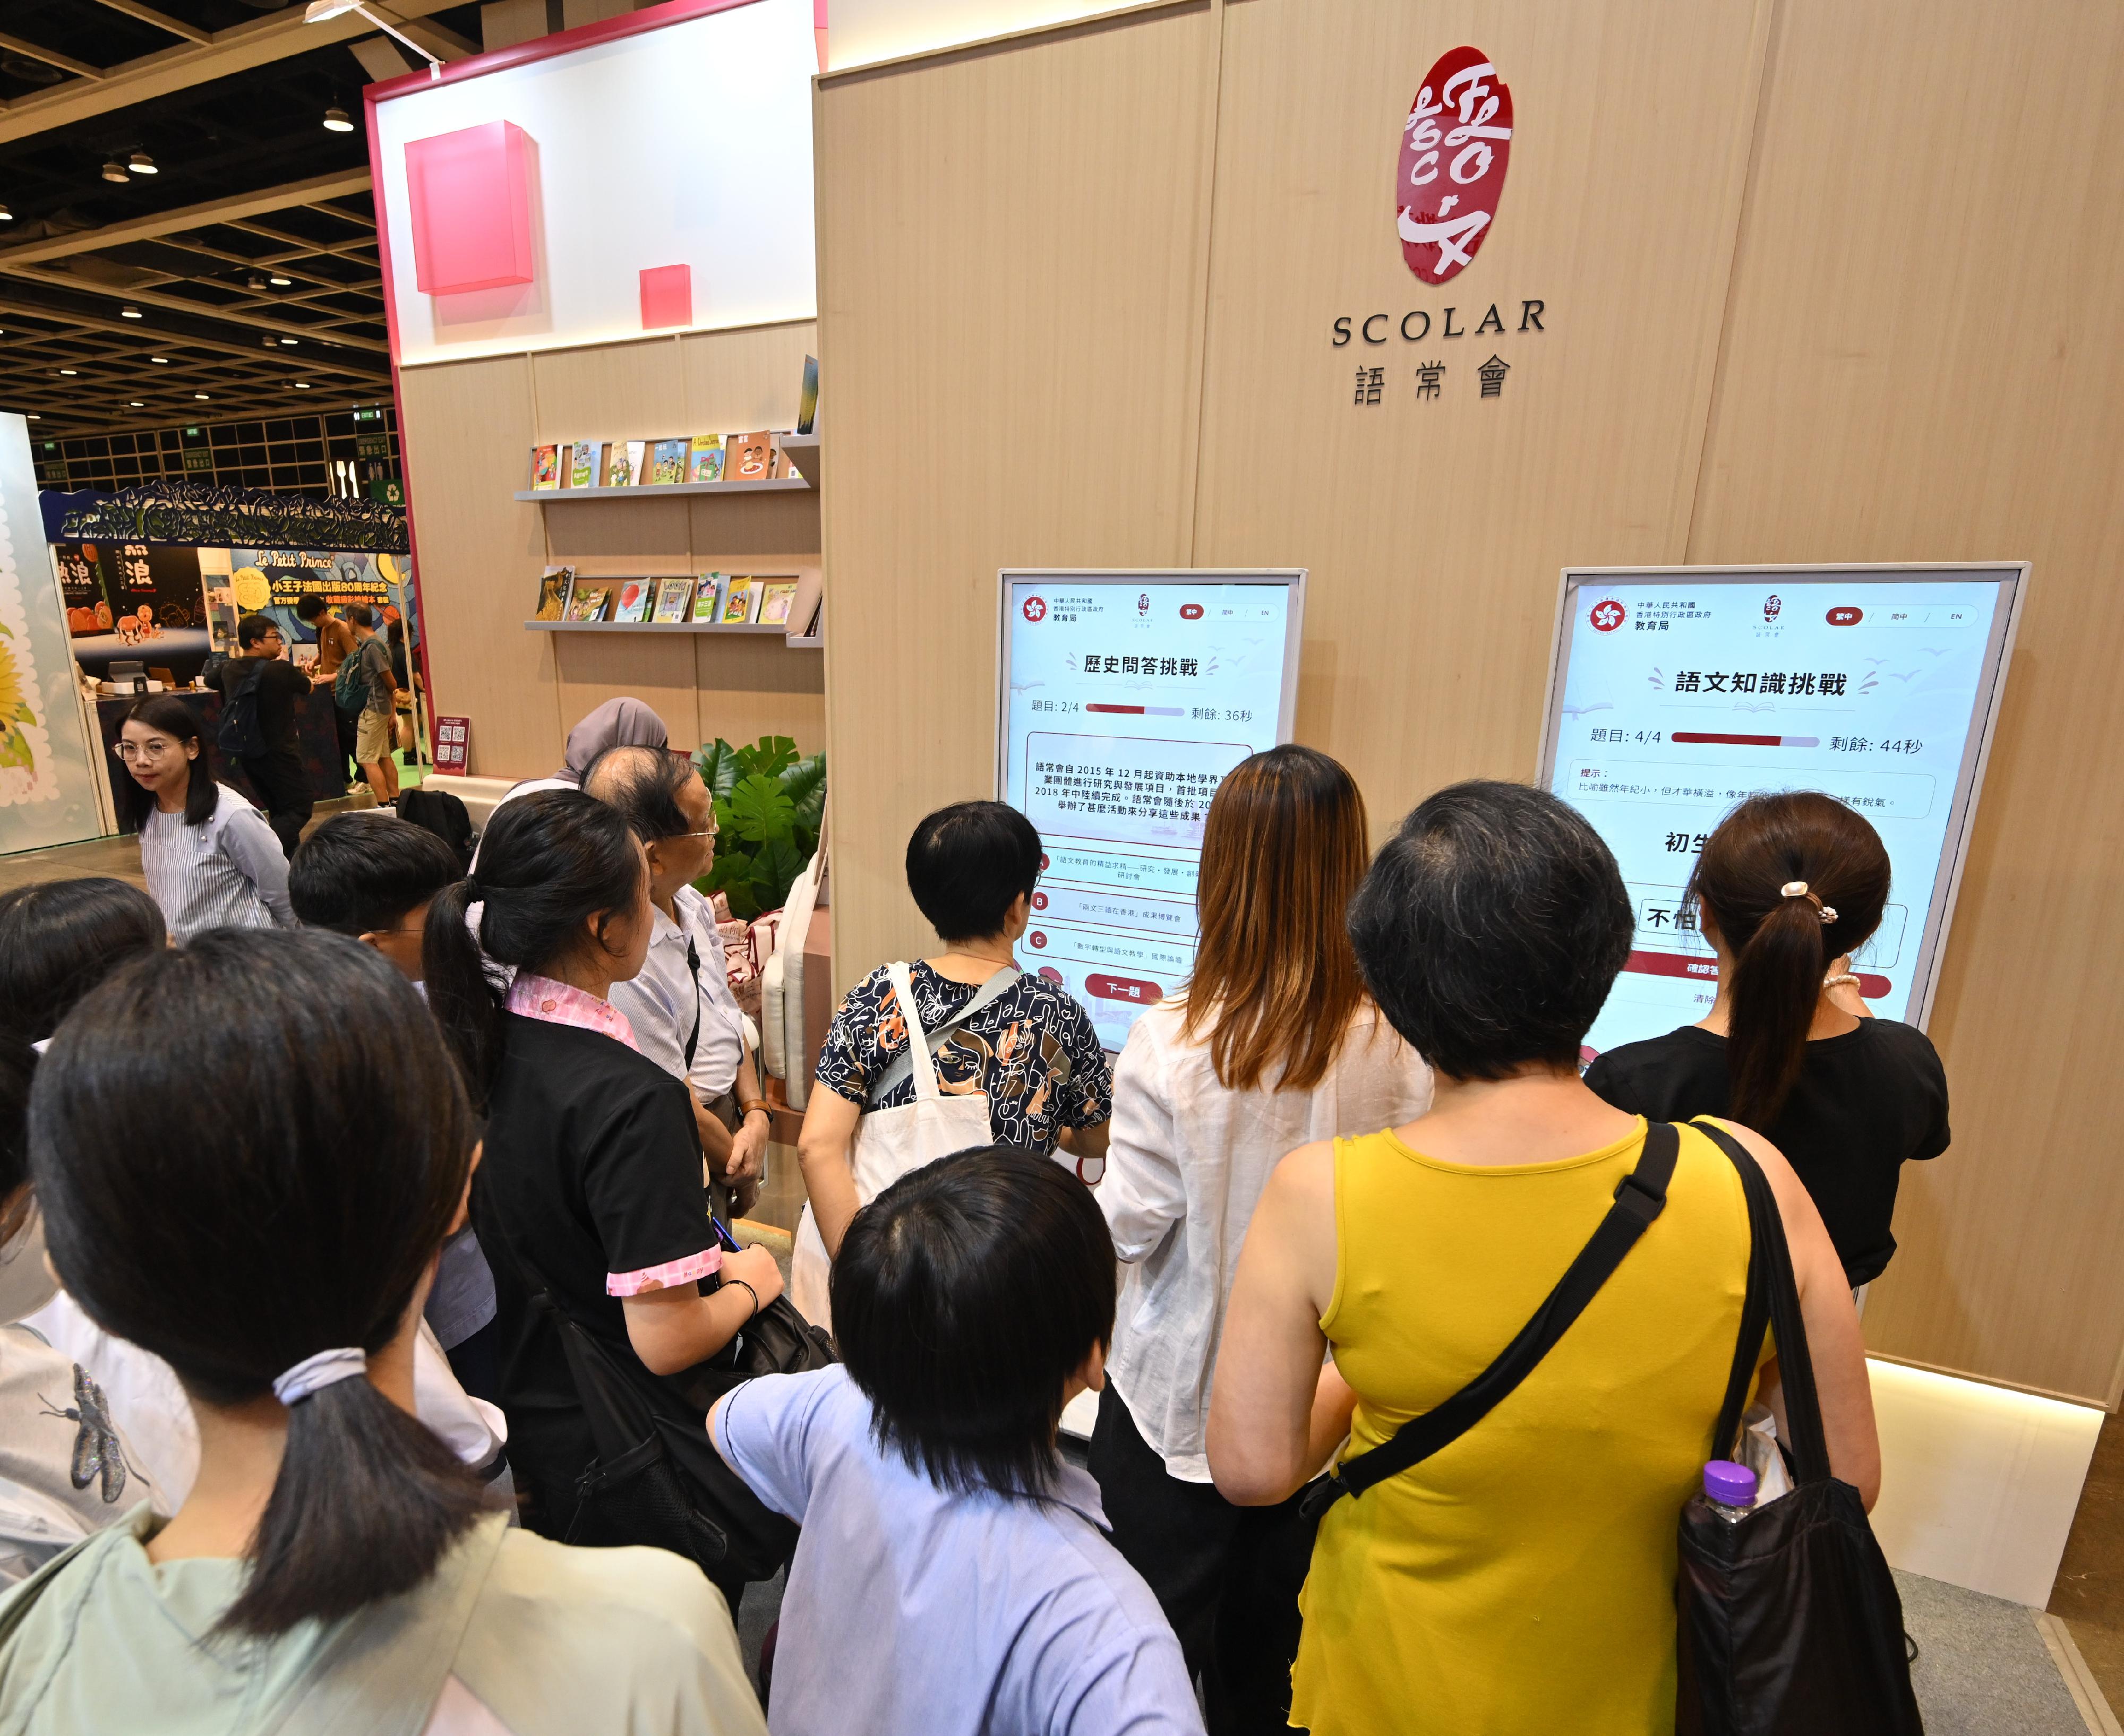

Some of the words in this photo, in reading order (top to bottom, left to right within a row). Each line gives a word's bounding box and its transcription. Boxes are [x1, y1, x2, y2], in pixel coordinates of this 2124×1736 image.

[1333, 300, 1545, 346] SCOLAR
[1355, 354, 1510, 405] 語常會
[255, 550, 268, 567] Le
[270, 551, 297, 568] Petit
[299, 552, 332, 569] Prince
[663, 580, 687, 590] LOOK
[1634, 621, 1669, 631] 教育局
[1084, 655, 1198, 677] 歷史問答挑戰
[1675, 671, 1848, 697] 語文知識挑戰
[1031, 700, 1058, 712] 題目:
[1061, 701, 1079, 713] 2/4
[1192, 707, 1220, 720] 剩餘:
[1224, 710, 1253, 722] 36秒
[1590, 727, 1629, 743] 題目:
[1635, 730, 1661, 744] 4/4
[1829, 736, 1873, 752] 剩餘:
[1880, 739, 1923, 755] 44秒
[1036, 762, 1074, 775] 語常會自
[1077, 766, 1101, 776] 2015
[1105, 767, 1115, 777] 年
[1118, 769, 1129, 778] 12
[1134, 770, 1226, 786] 月起資助本地學界
[1035, 787, 1058, 796] 2018
[1117, 871, 1141, 881] 研討會
[1647, 908, 1696, 931] 不怕
[1107, 982, 1141, 998] 下一題
[1693, 994, 1716, 1005] 清除
